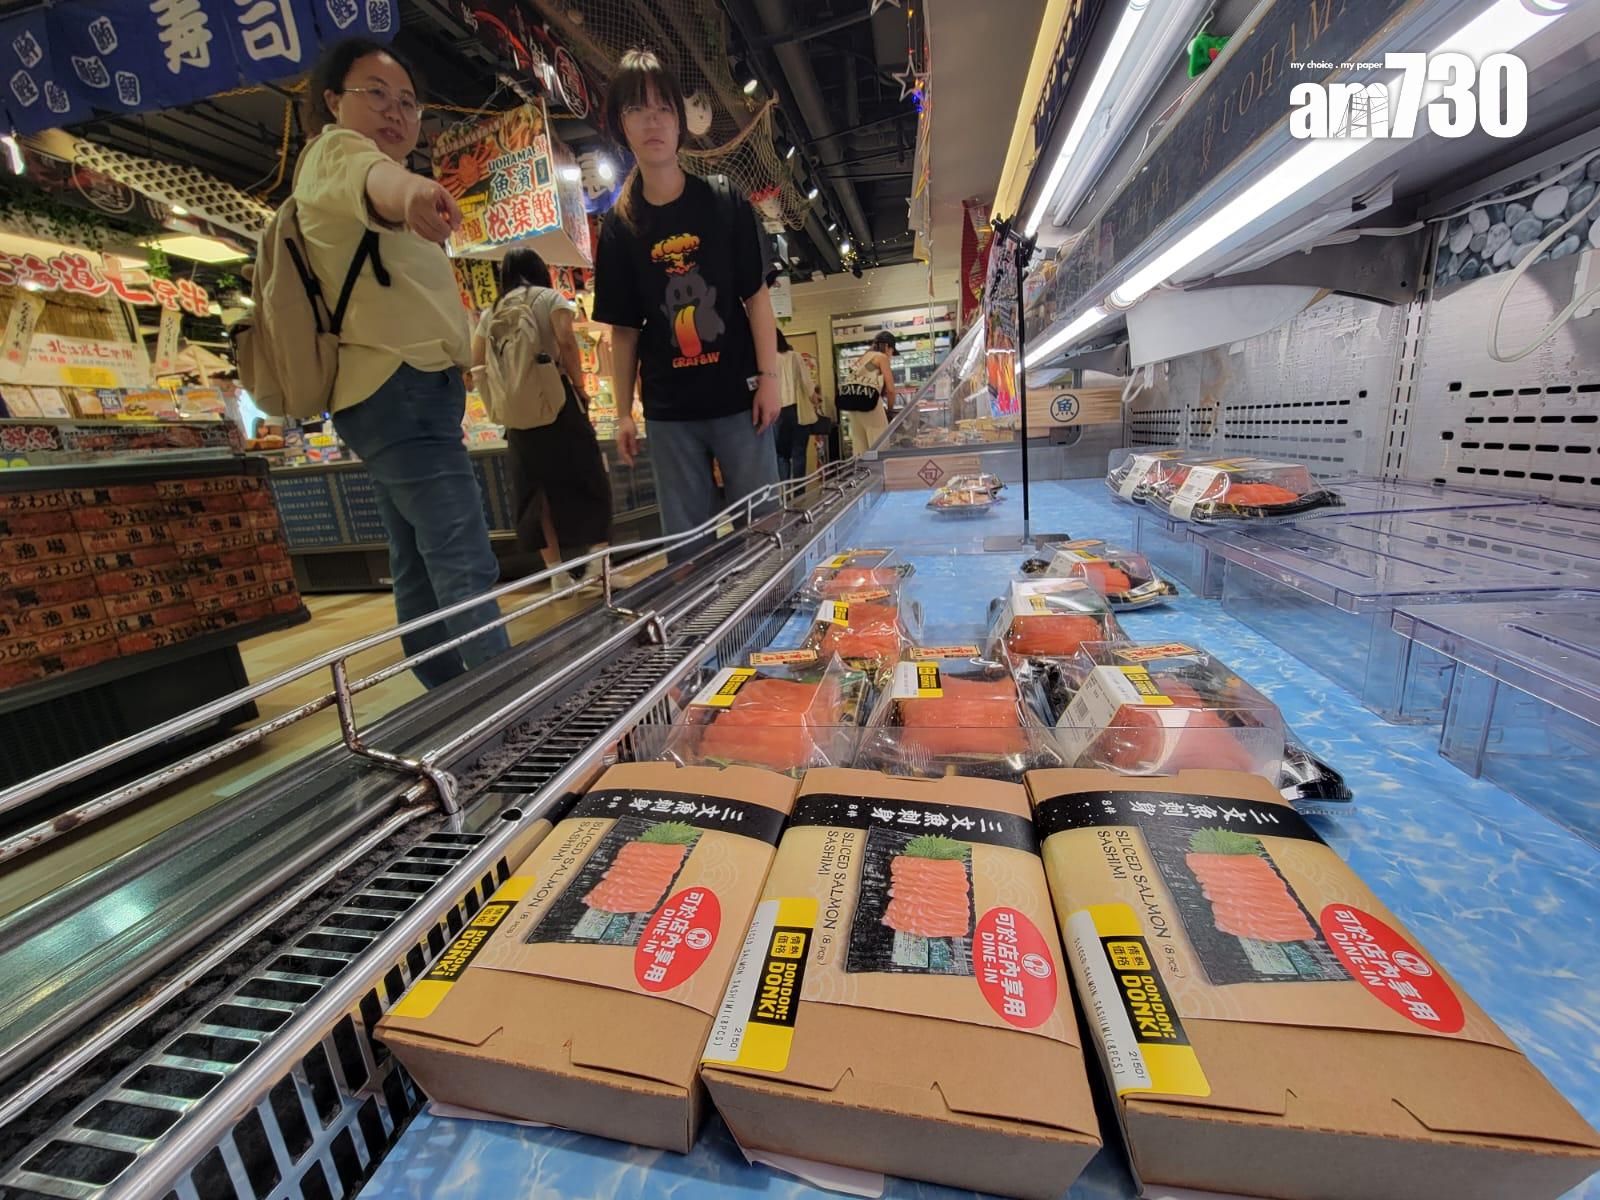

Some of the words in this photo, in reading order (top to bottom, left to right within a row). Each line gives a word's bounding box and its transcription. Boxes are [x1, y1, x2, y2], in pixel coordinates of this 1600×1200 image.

[629, 797, 745, 821] 三文魚刺身
[871, 807, 1003, 833] 三文魚刺身
[1129, 800, 1280, 825] 三文魚刺身
[553, 821, 591, 862] SASHIMI
[575, 821, 604, 855] SLICED
[818, 830, 839, 876] SASHIMI
[839, 831, 855, 870] SLICED
[1098, 830, 1127, 879] SASHIMI
[529, 856, 576, 910] SALMON
[826, 872, 847, 930] SALMON
[1115, 830, 1142, 872] SLICED
[1133, 875, 1172, 939] SALMON
[431, 929, 475, 976] DONKI
[643, 908, 676, 953] DINE-IN
[981, 931, 999, 984] DINE-IN
[1331, 932, 1386, 987] DINE-IN
[757, 962, 786, 1019] DONKI
[1121, 975, 1161, 1038] DONKI
